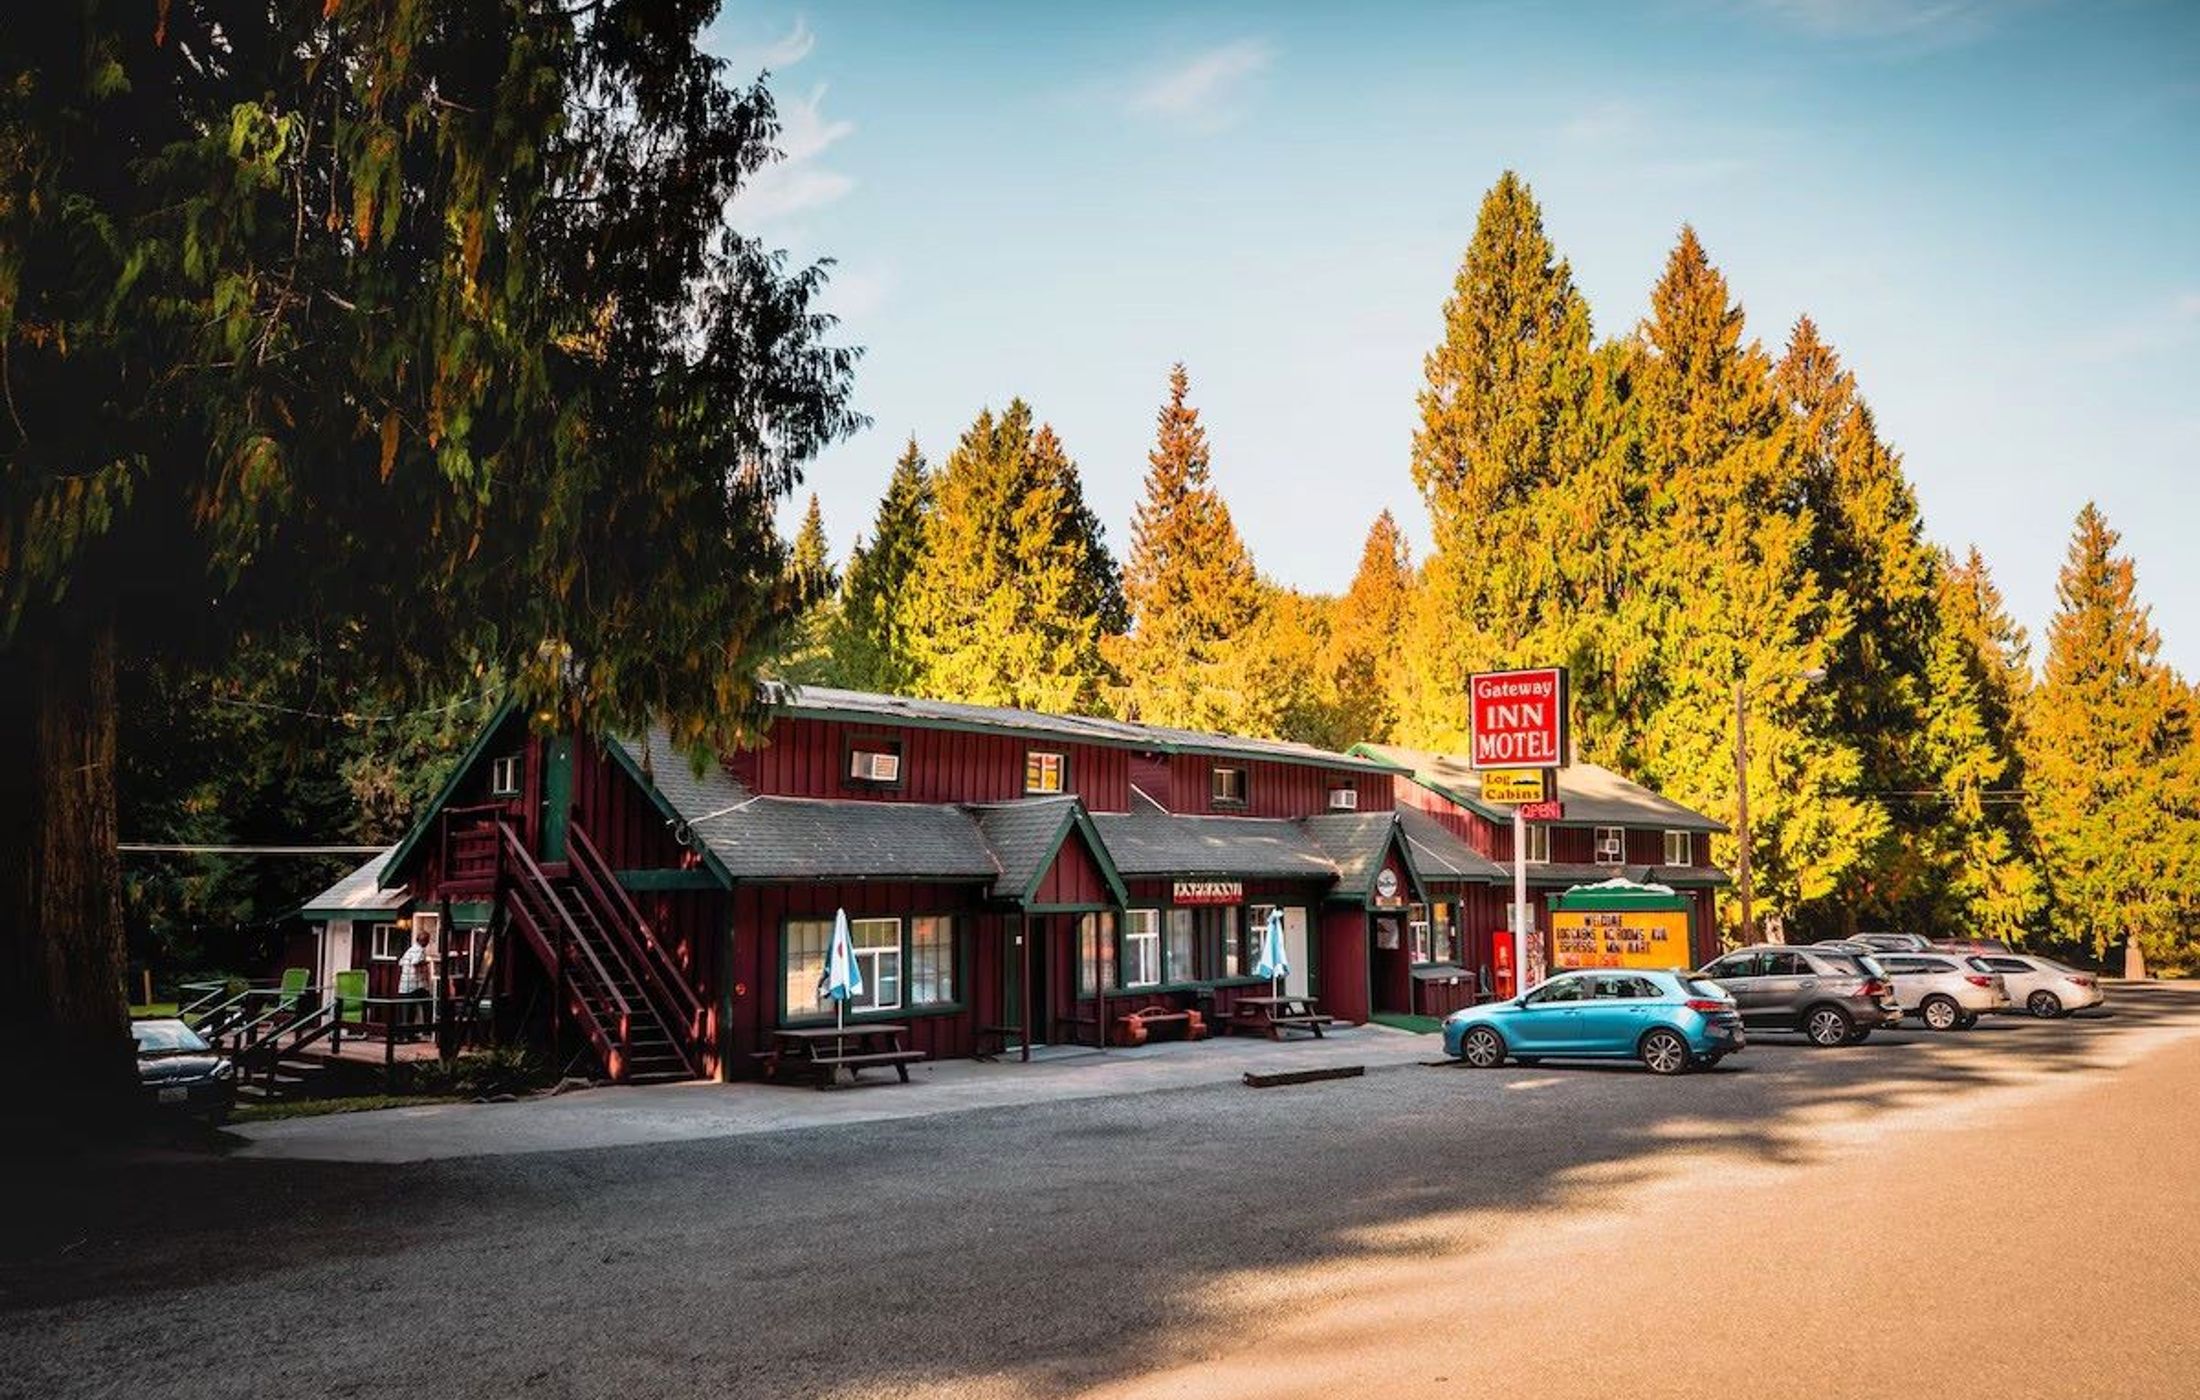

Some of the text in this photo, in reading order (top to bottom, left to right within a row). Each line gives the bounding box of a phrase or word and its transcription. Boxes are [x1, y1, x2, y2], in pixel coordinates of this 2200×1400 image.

[1478, 680, 1552, 699] Gateway
[1487, 703, 1544, 729] INN
[1478, 731, 1555, 759] MOTEL
[1485, 788, 1541, 800] Cabins
[1521, 803, 1560, 818] OPEN
